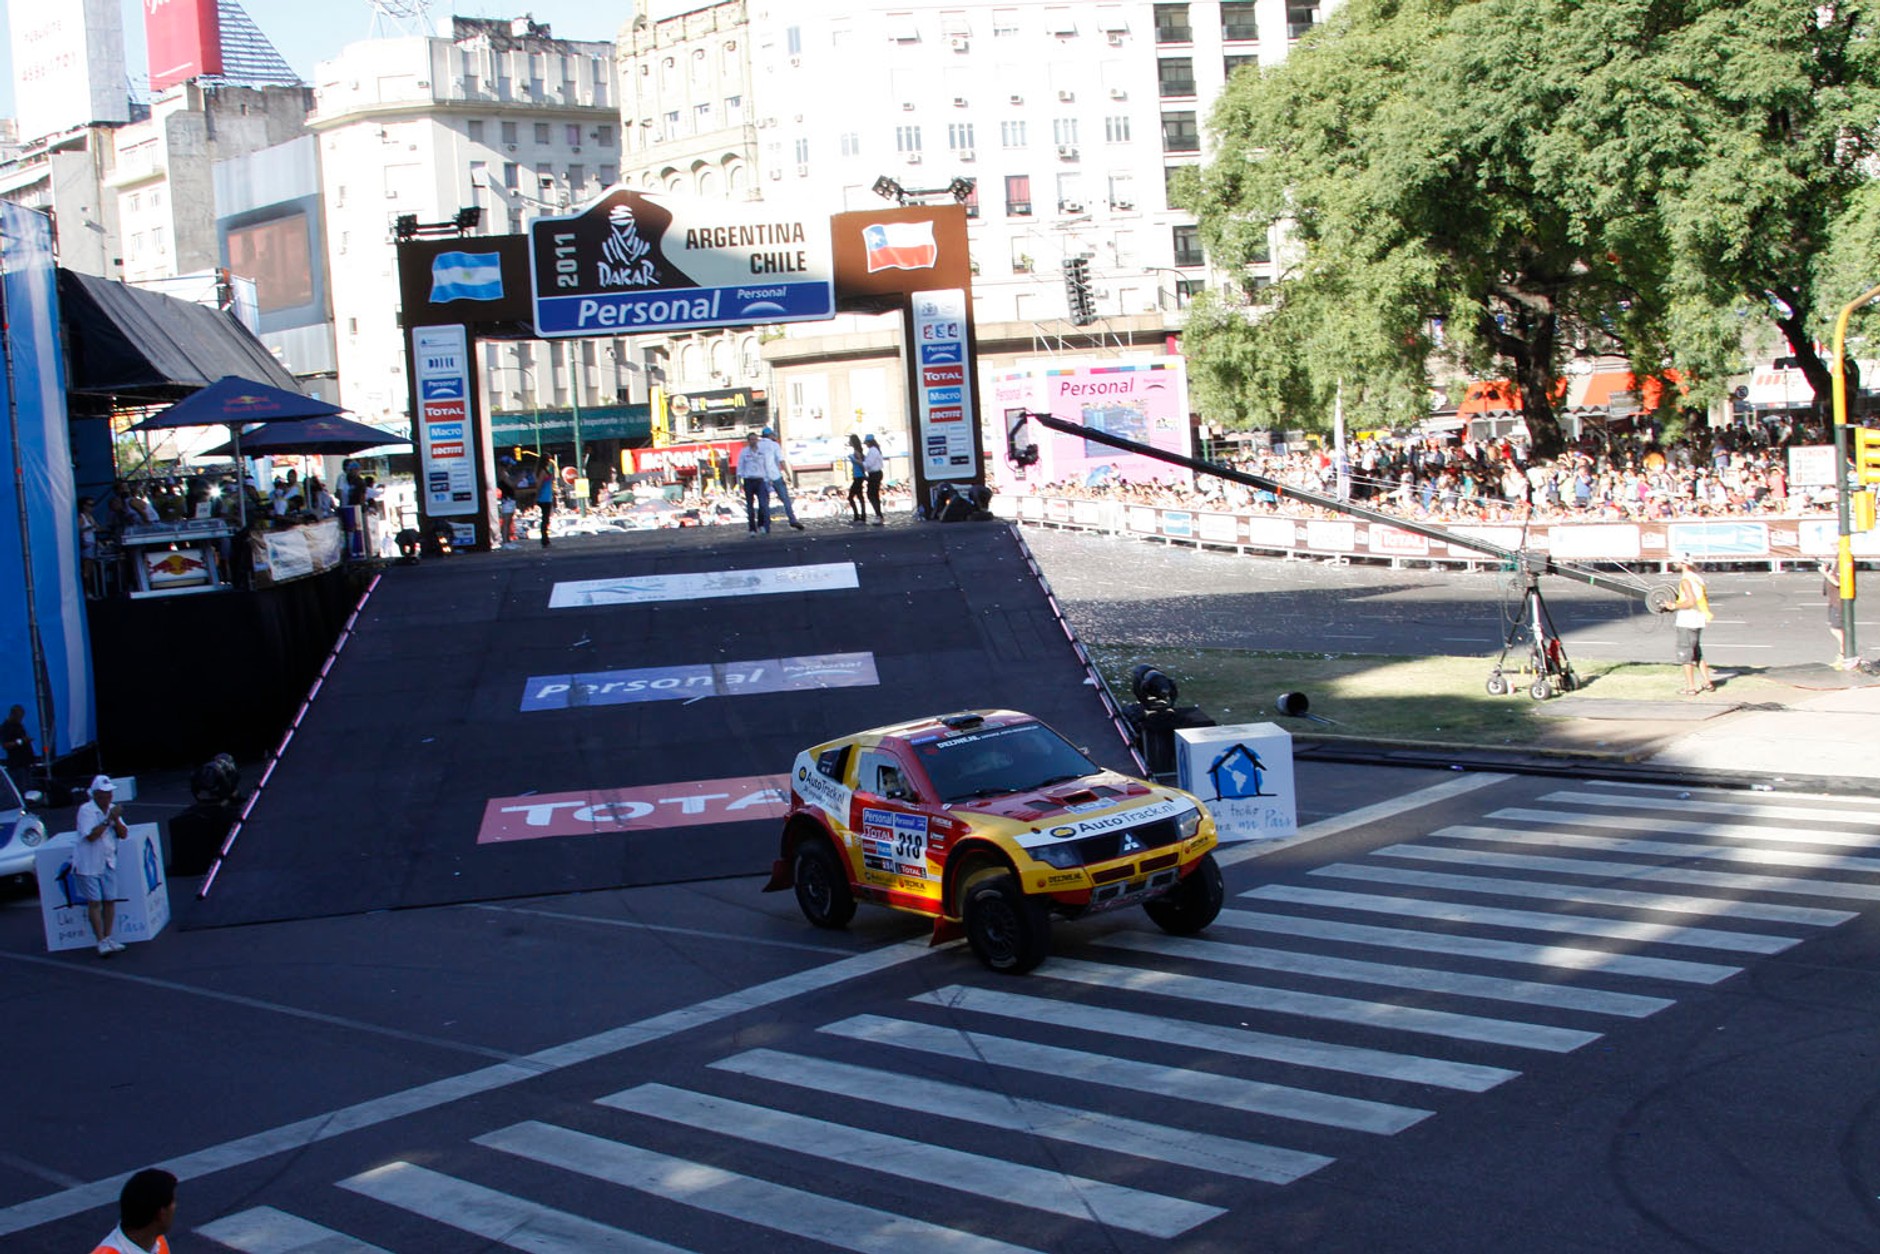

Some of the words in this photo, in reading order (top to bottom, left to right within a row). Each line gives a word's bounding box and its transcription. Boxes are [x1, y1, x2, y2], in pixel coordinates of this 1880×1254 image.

[685, 222, 805, 250] ARGENTINA
[554, 233, 579, 287] 2011
[750, 251, 807, 274] CHILE
[597, 259, 659, 288] DAKAR
[737, 286, 787, 299] Personal
[578, 289, 721, 328] Personal
[924, 371, 963, 380] TOTAL
[1060, 377, 1134, 396] Personal
[929, 391, 960, 401] Macro
[425, 407, 464, 416] TOTAL
[431, 427, 462, 437] Macro
[536, 667, 764, 700] Personal
[806, 771, 845, 805] AutoTrack.nl
[501, 788, 792, 826] TOTA
[865, 811, 892, 825] Personal
[1080, 802, 1176, 833] AutoTrack.nl
[864, 825, 893, 842] TOTAL
[896, 832, 923, 860] 318
